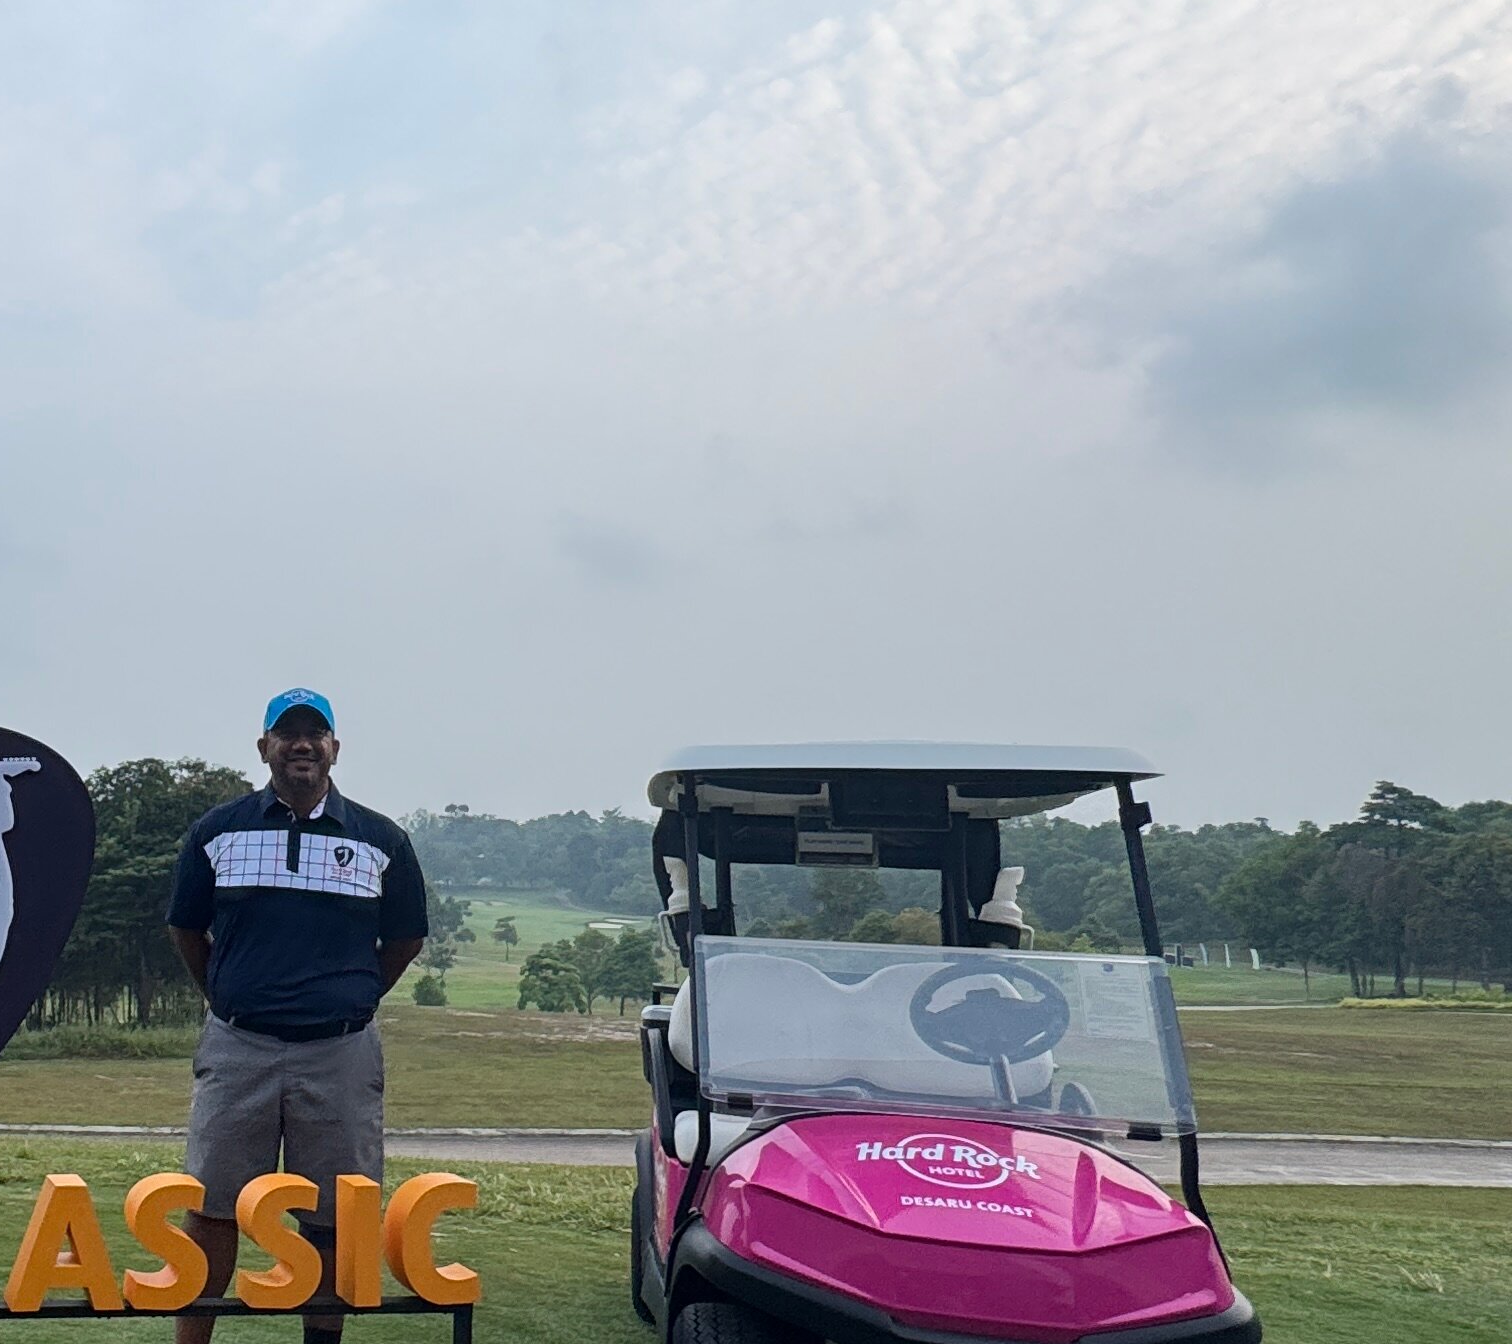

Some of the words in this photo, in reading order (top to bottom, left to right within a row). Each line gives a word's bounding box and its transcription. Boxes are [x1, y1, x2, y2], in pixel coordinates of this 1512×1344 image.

[856, 1142, 944, 1161] Hard
[950, 1145, 1042, 1179] Rock
[928, 1166, 984, 1179] HOTEL
[901, 1196, 972, 1210] DESARU
[977, 1201, 1034, 1217] COAST
